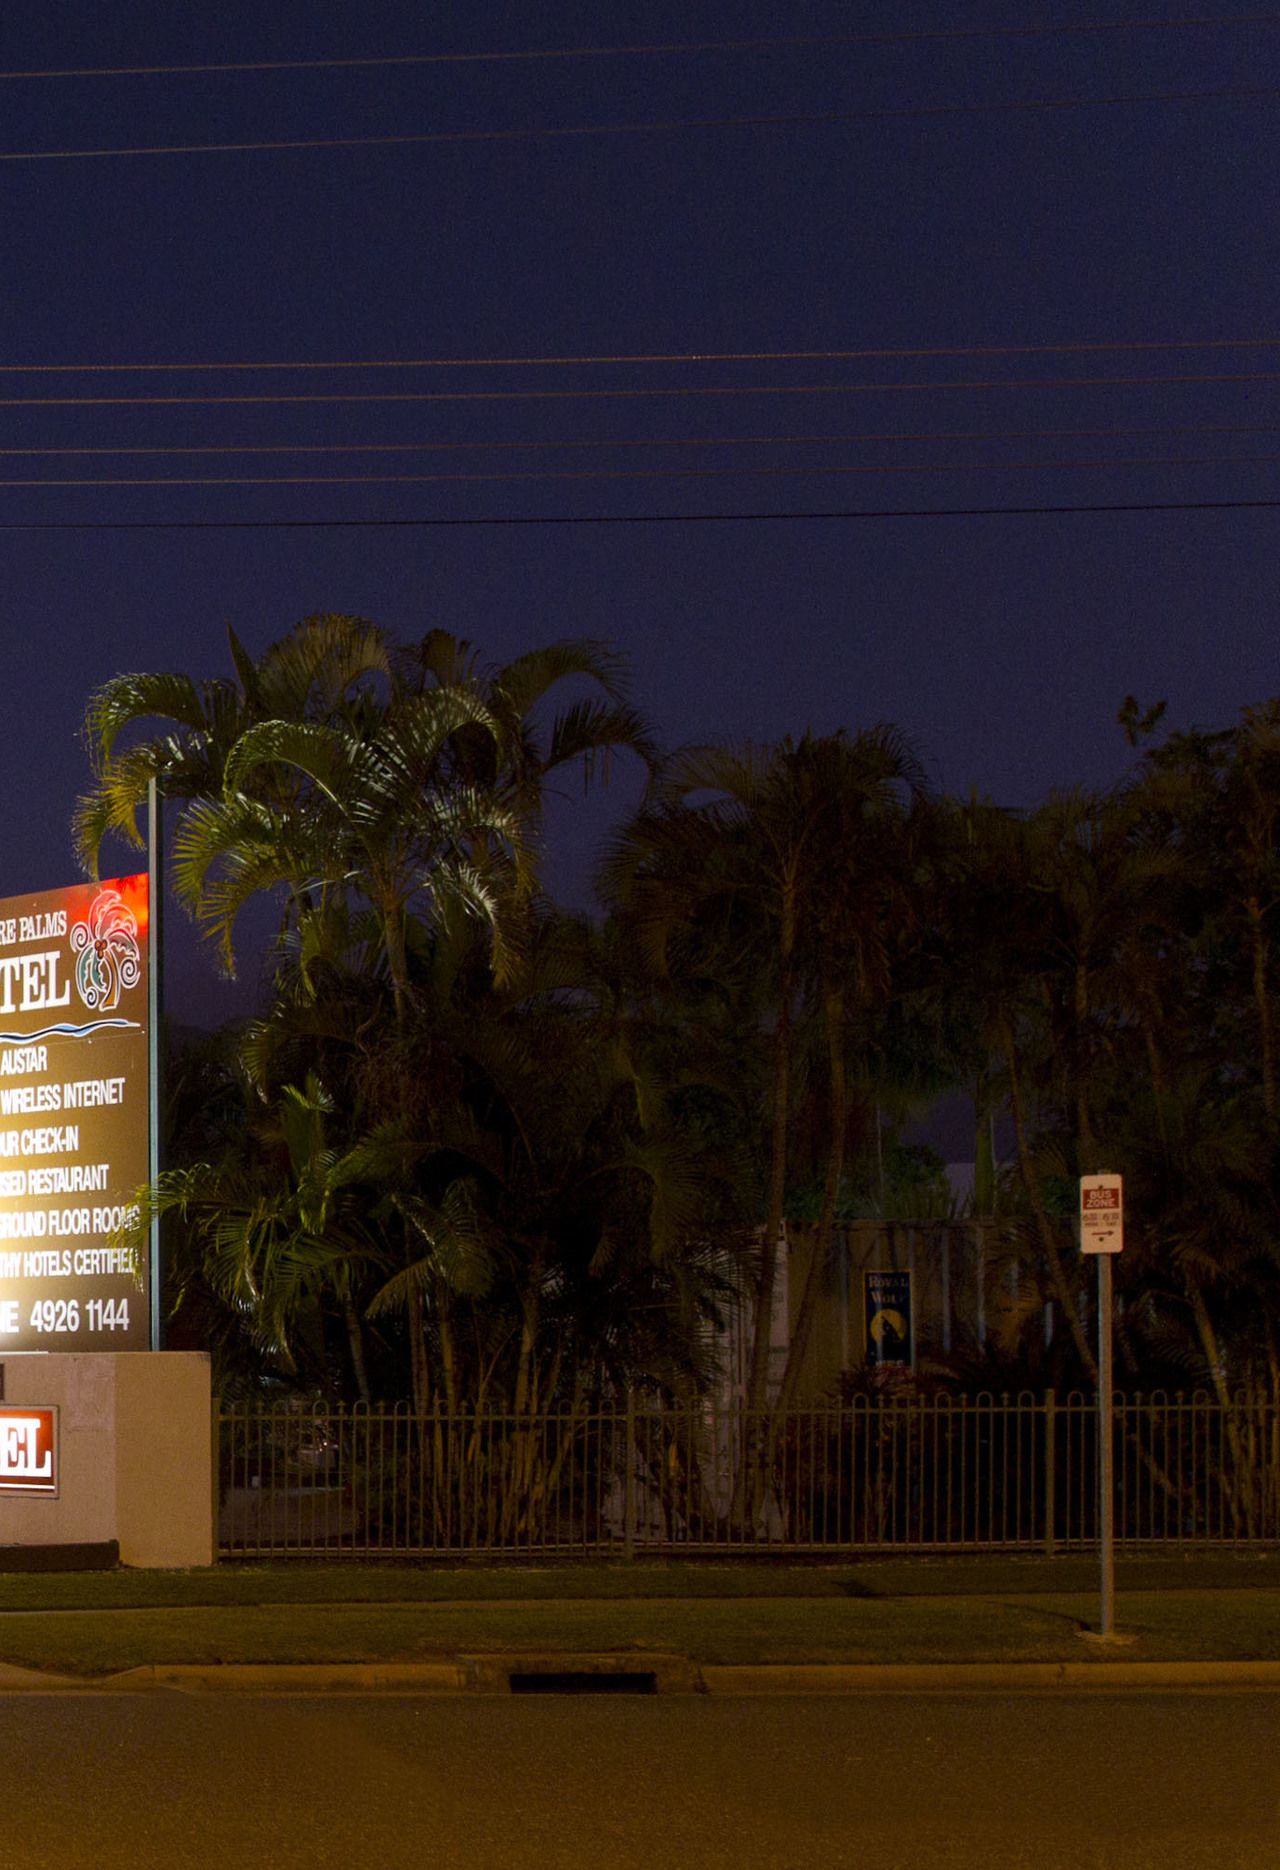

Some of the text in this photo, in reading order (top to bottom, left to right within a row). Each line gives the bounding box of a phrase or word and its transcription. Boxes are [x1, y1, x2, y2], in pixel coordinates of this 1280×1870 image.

[18, 910, 68, 942] PALMS
[0, 1046, 48, 1076] AUSTAR
[0, 1084, 62, 1115] WIRELESS
[63, 1077, 126, 1109] INTERNET
[21, 1125, 79, 1155] CHECK-IN
[28, 1164, 110, 1195] RESTAURANT
[1086, 1198, 1115, 1208] ZONE
[1089, 1190, 1112, 1200] BUS
[48, 1208, 90, 1235] FLOOR
[23, 1250, 72, 1277] HOTELS
[30, 1300, 80, 1333] 4926
[85, 1298, 130, 1332] 1144
